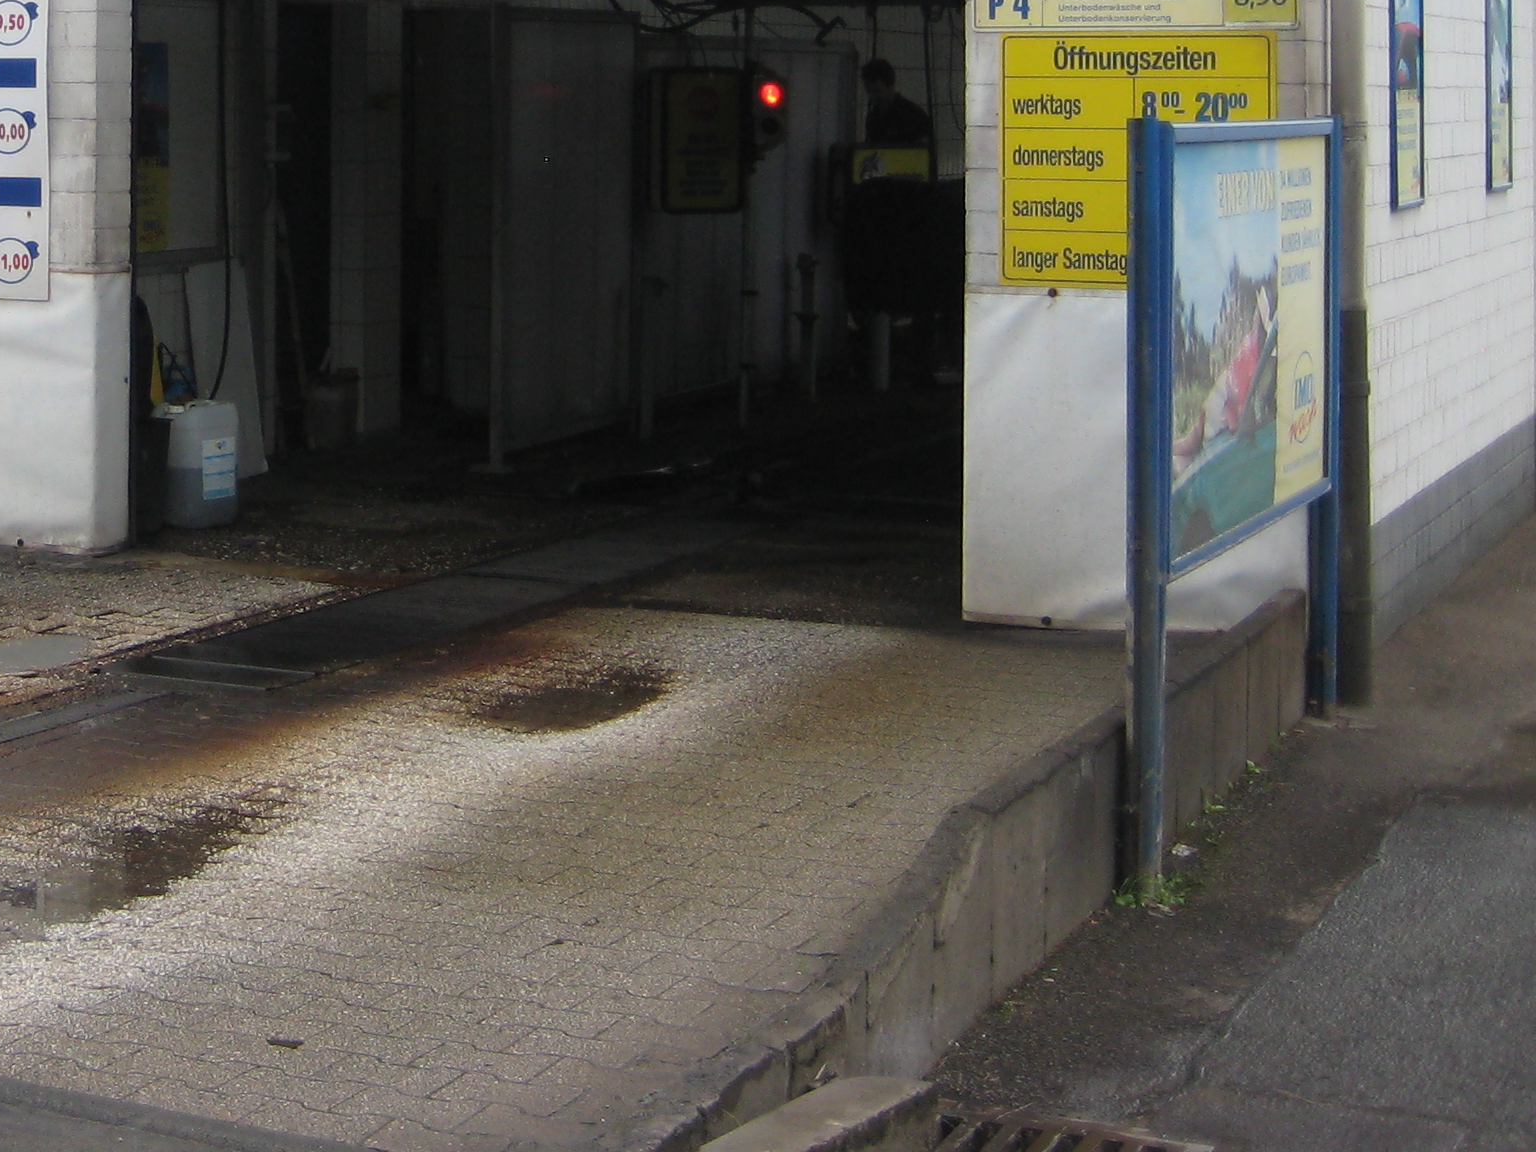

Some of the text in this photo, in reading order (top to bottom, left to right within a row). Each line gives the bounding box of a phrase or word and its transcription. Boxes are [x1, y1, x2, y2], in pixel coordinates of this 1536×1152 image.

[1058, 3, 1161, 12] Unterbodenwäsche und
[1058, 14, 1172, 24] Unterbodenkonservierung
[1054, 41, 1216, 75] Öffnungszeiten
[1013, 94, 1081, 117] werktags
[1013, 144, 1104, 172] donnerstags
[1013, 197, 1084, 222] samstags
[1013, 245, 1057, 273] langer
